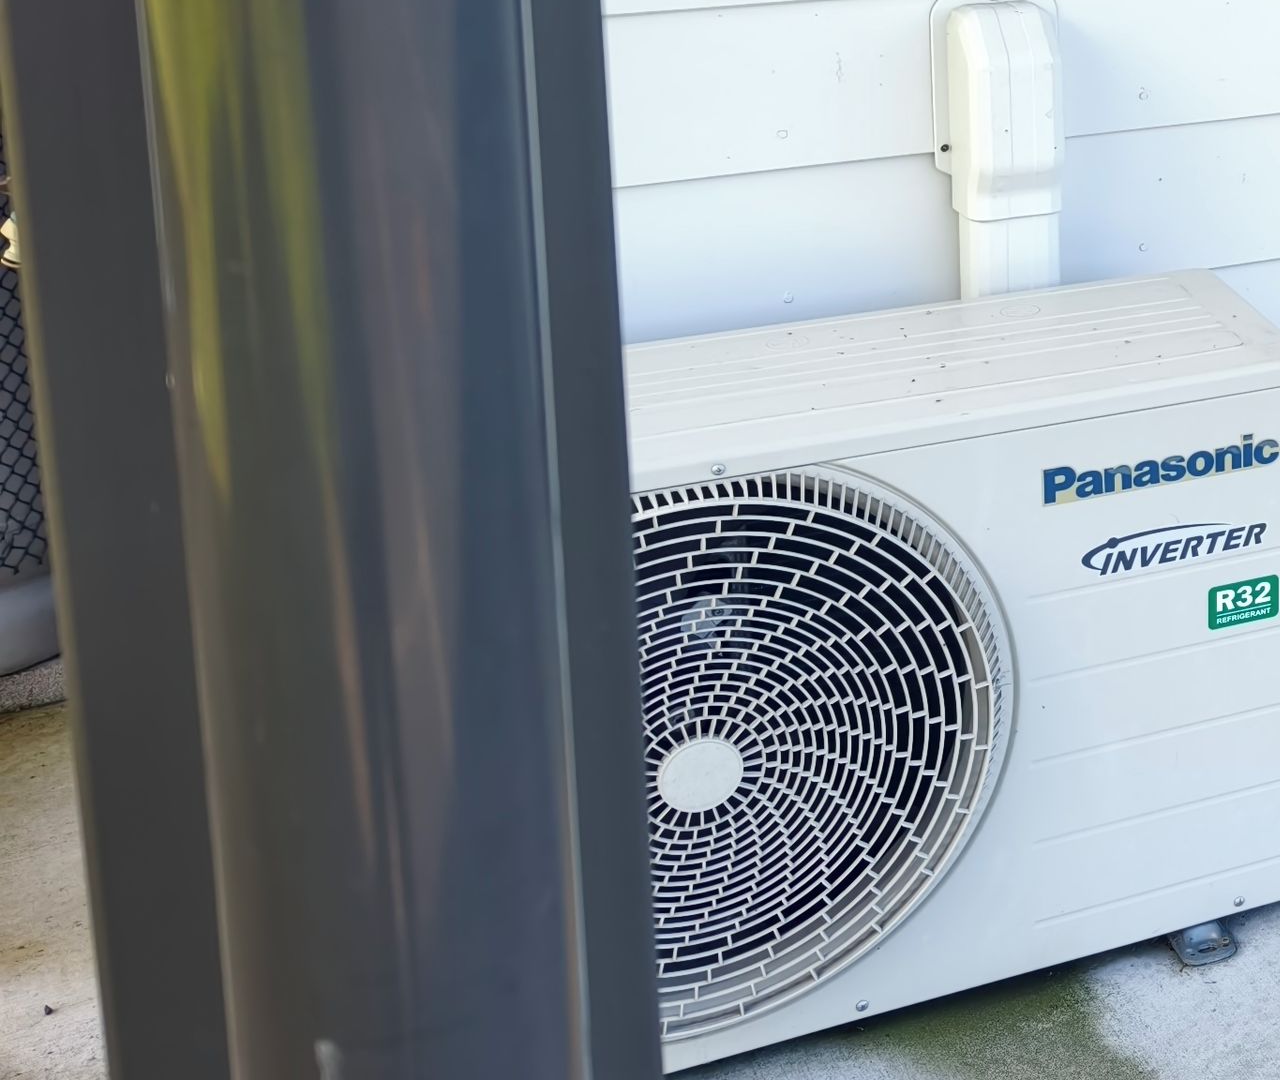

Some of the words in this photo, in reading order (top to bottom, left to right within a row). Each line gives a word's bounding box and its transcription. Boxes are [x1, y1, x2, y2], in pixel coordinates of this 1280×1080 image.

[1042, 433, 1280, 505] Panasonic
[1099, 522, 1267, 576] INVERTER
[1216, 581, 1272, 612] R32
[1216, 607, 1272, 625] REFRIGERANT
